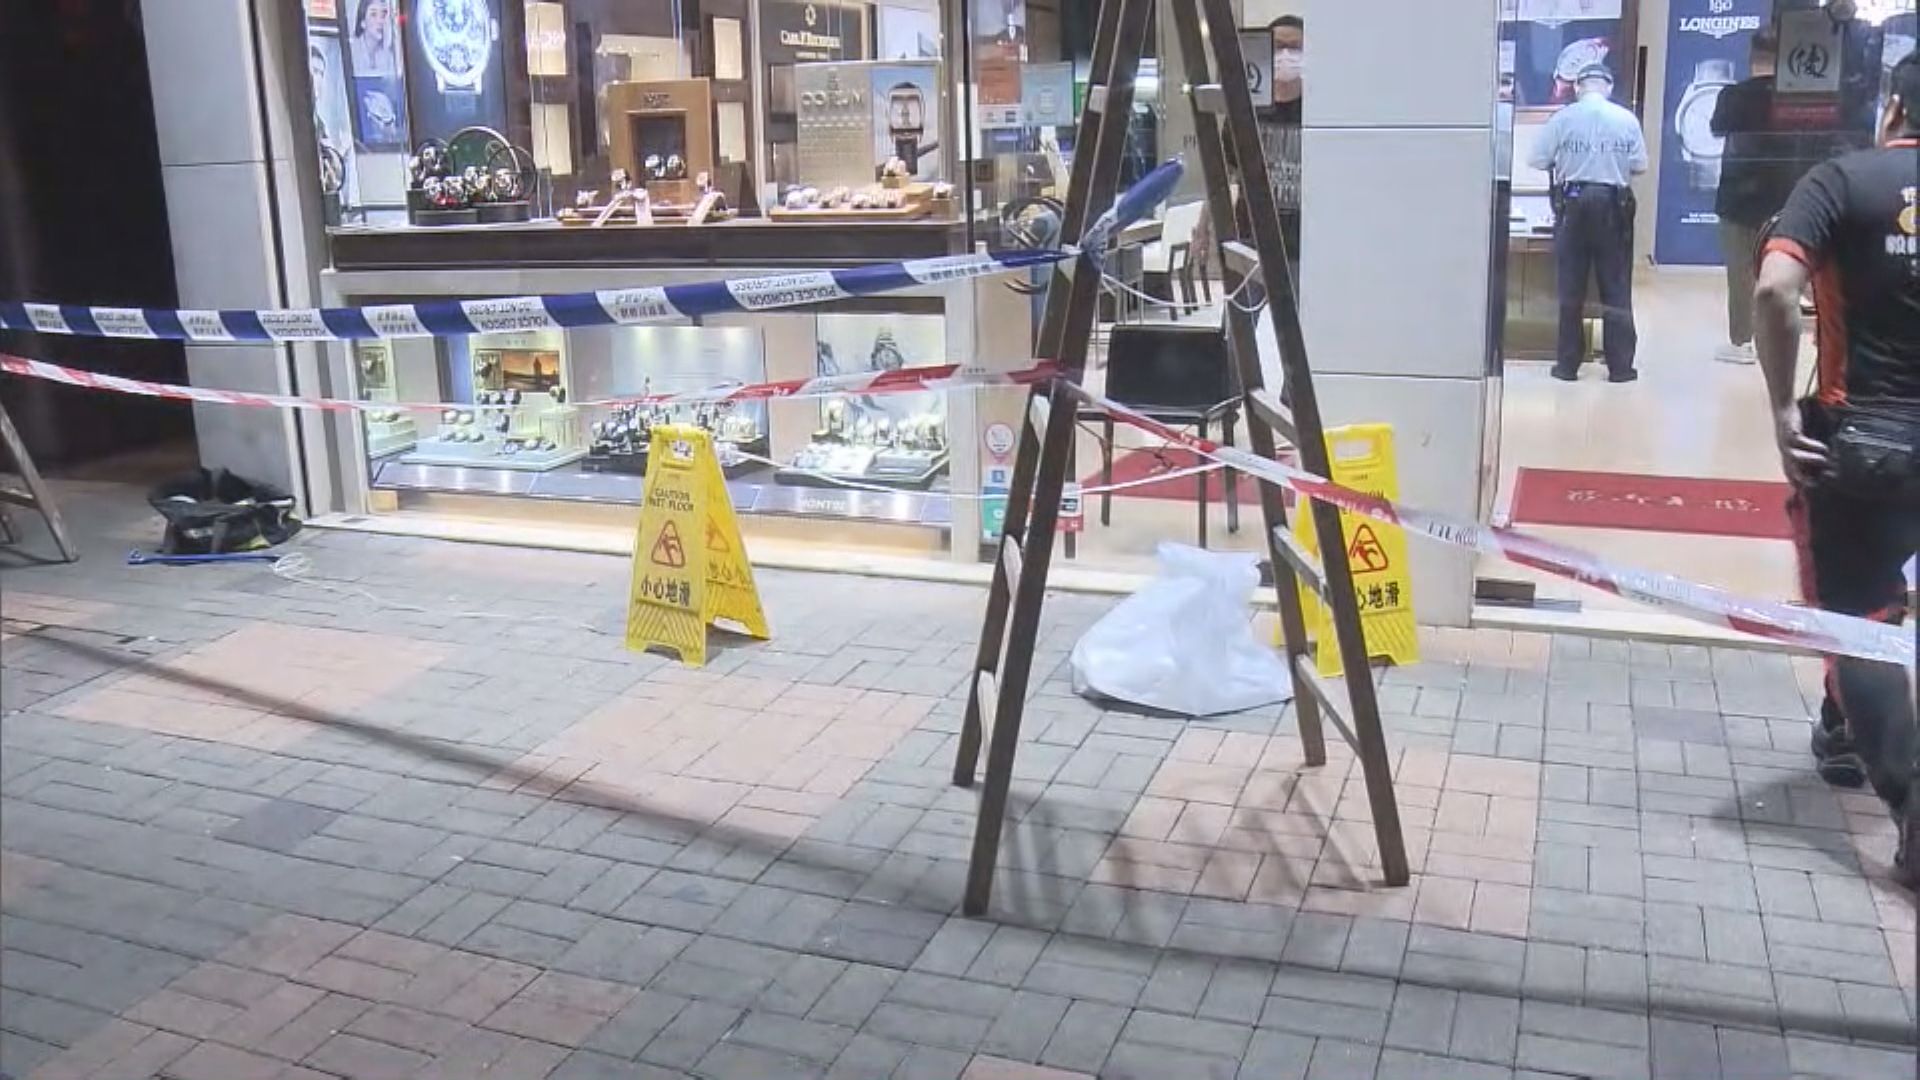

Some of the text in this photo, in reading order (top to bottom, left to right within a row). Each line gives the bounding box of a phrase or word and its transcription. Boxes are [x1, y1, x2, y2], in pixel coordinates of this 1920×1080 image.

[1679, 16, 1760, 31] LONGINES
[795, 287, 837, 300] POLICE
[655, 488, 690, 501] CAUTION
[668, 500, 694, 511] FLOOR
[641, 577, 691, 606] 小心地滑
